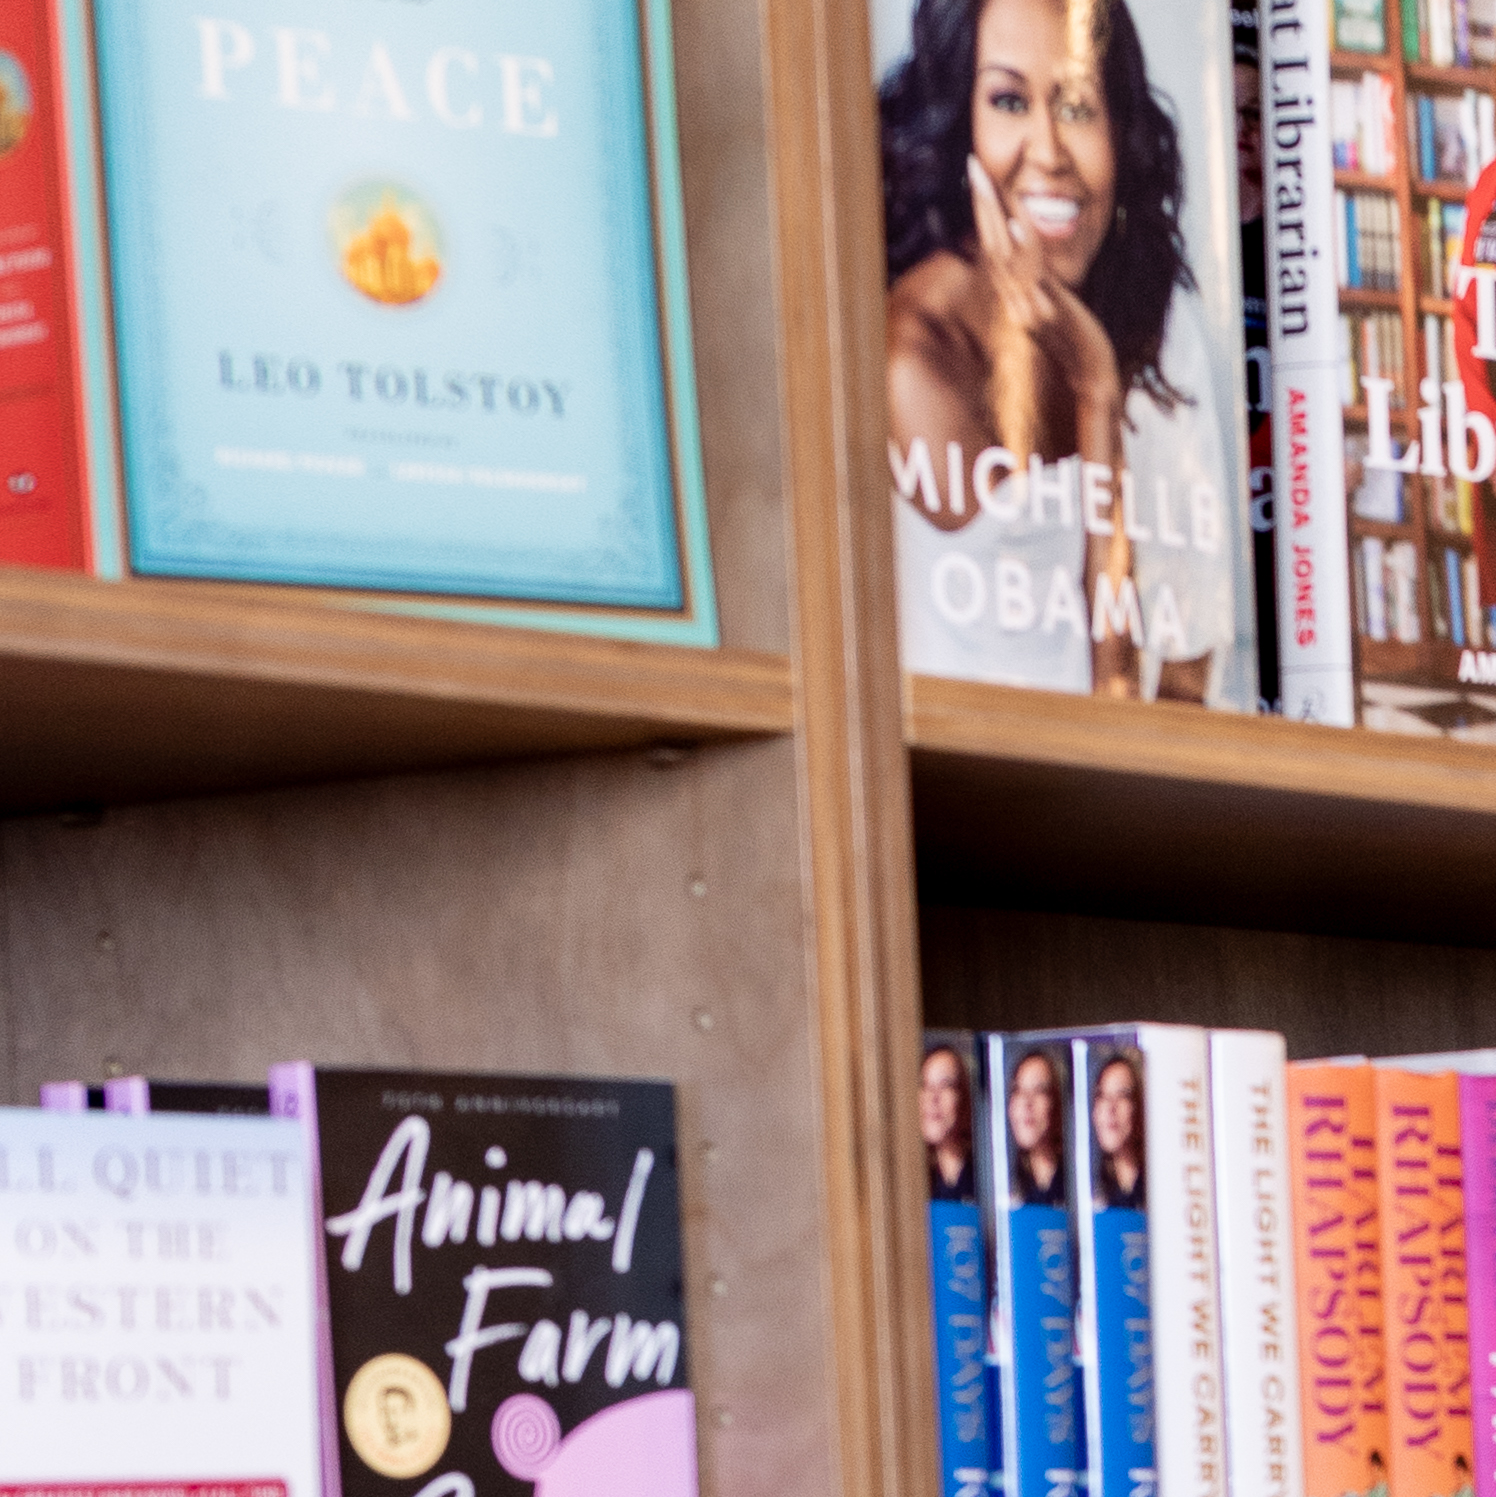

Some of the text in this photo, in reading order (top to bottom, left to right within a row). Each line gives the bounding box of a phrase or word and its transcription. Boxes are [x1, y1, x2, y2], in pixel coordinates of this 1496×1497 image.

[194, 12, 564, 139] PEACE
[216, 348, 574, 423] LEO TOLSTOY
[327, 1113, 655, 1296] Animal
[446, 1266, 683, 1413] Farm
